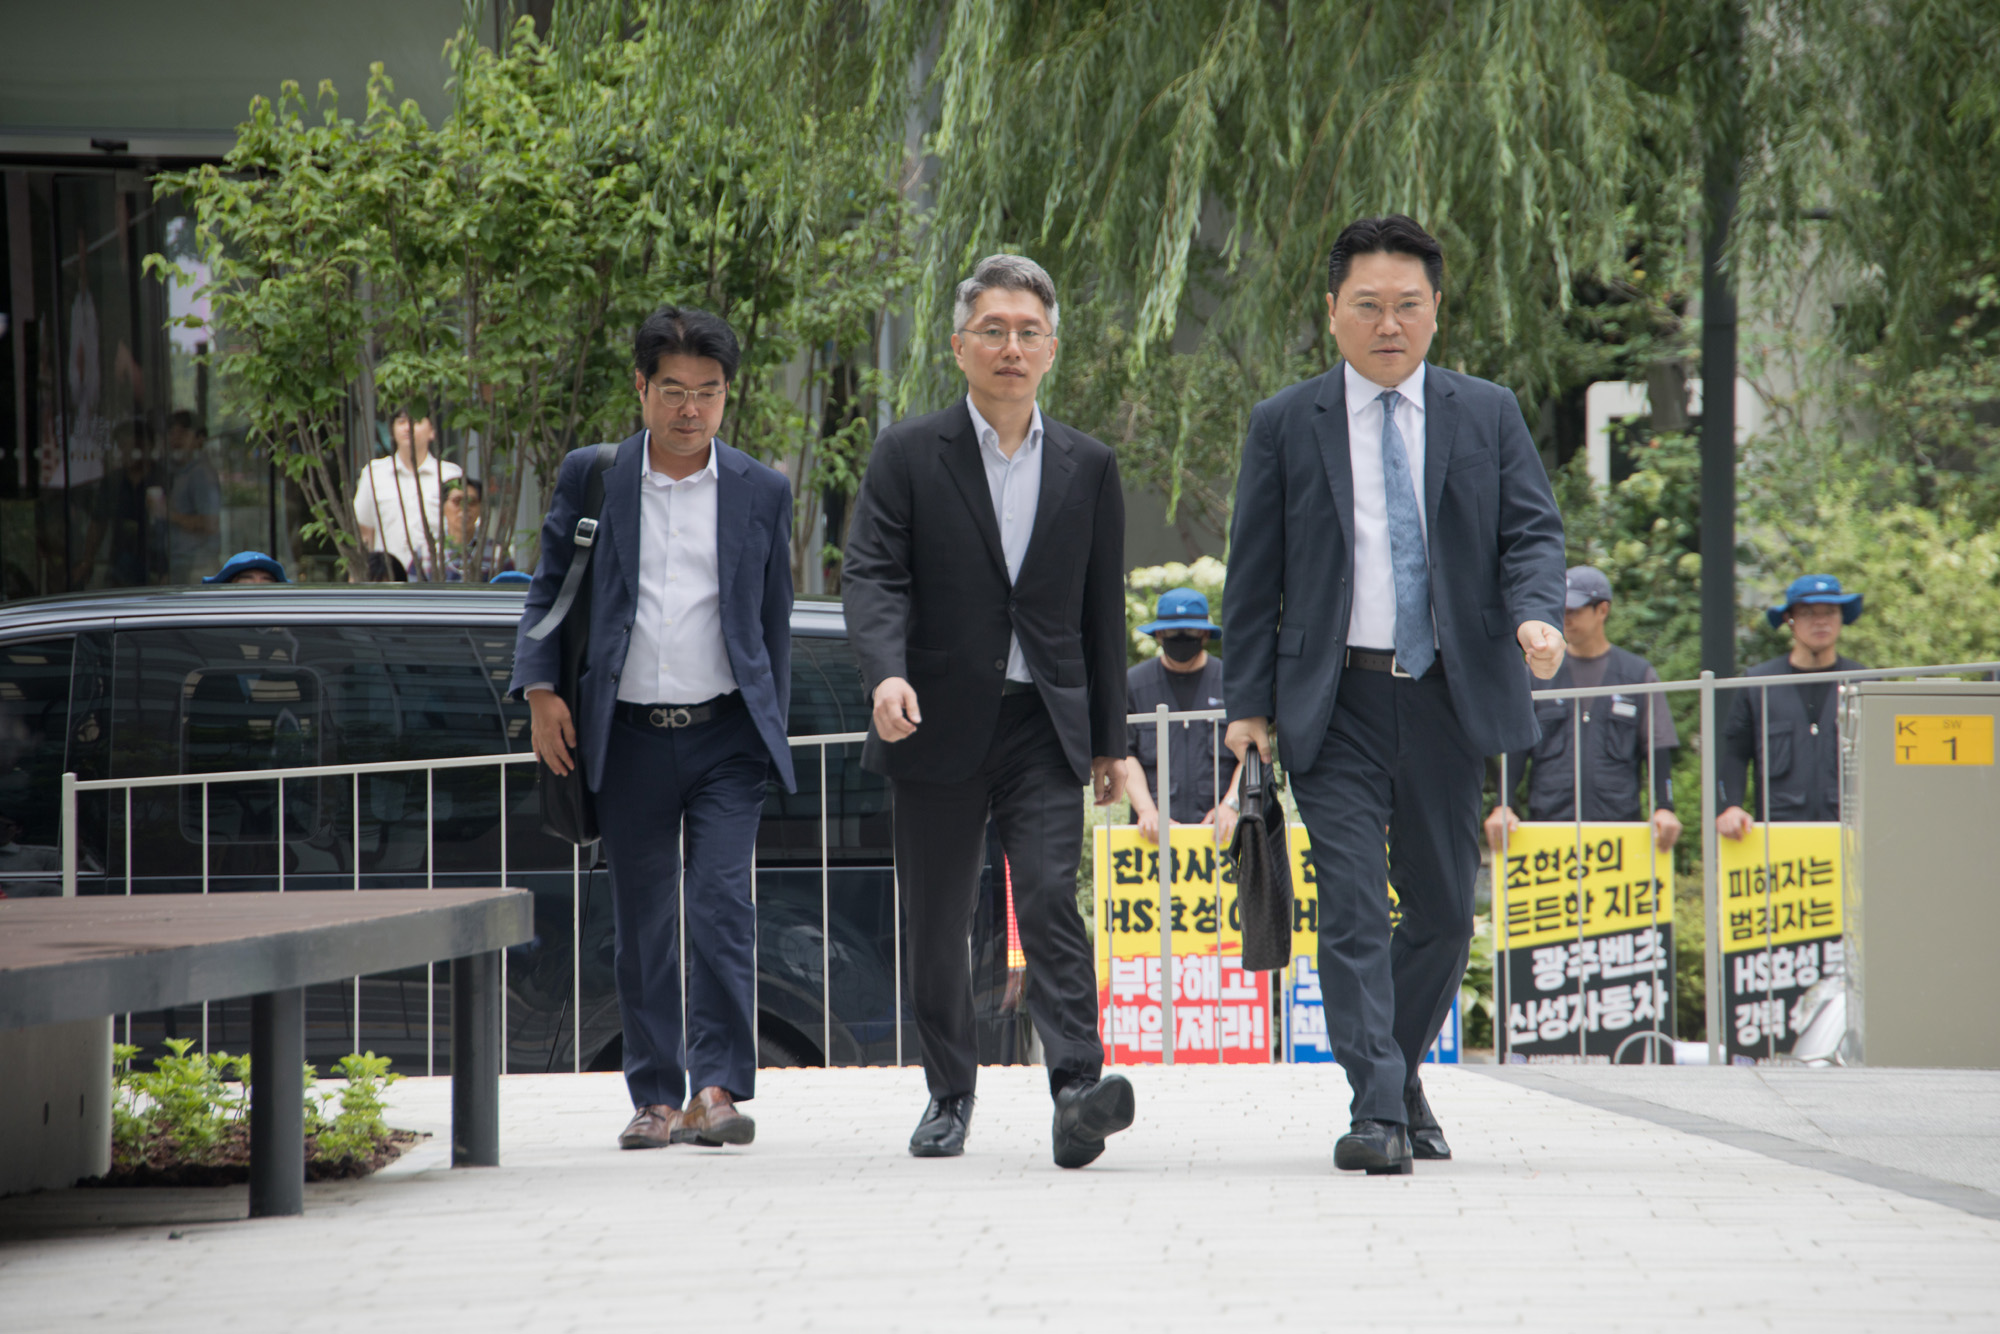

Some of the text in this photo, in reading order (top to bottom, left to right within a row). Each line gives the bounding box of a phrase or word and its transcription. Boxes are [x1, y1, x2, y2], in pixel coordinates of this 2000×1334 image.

[1943, 719, 1962, 729] SW
[1942, 736, 1957, 761] 1
[1503, 836, 1623, 889] 조현상의
[1728, 856, 1834, 899] 피해자는
[1503, 877, 1664, 937] 든든한 지갑
[1729, 897, 1834, 941] 범죄자는
[1110, 954, 1258, 1002] 부당해고
[1532, 928, 1668, 991] 광주벤츠
[1734, 943, 1820, 995] HS효성
[1103, 1004, 1265, 1052] 책임져라!
[1505, 978, 1669, 1046] 신성자동차
[1735, 998, 1786, 1047] 강력
